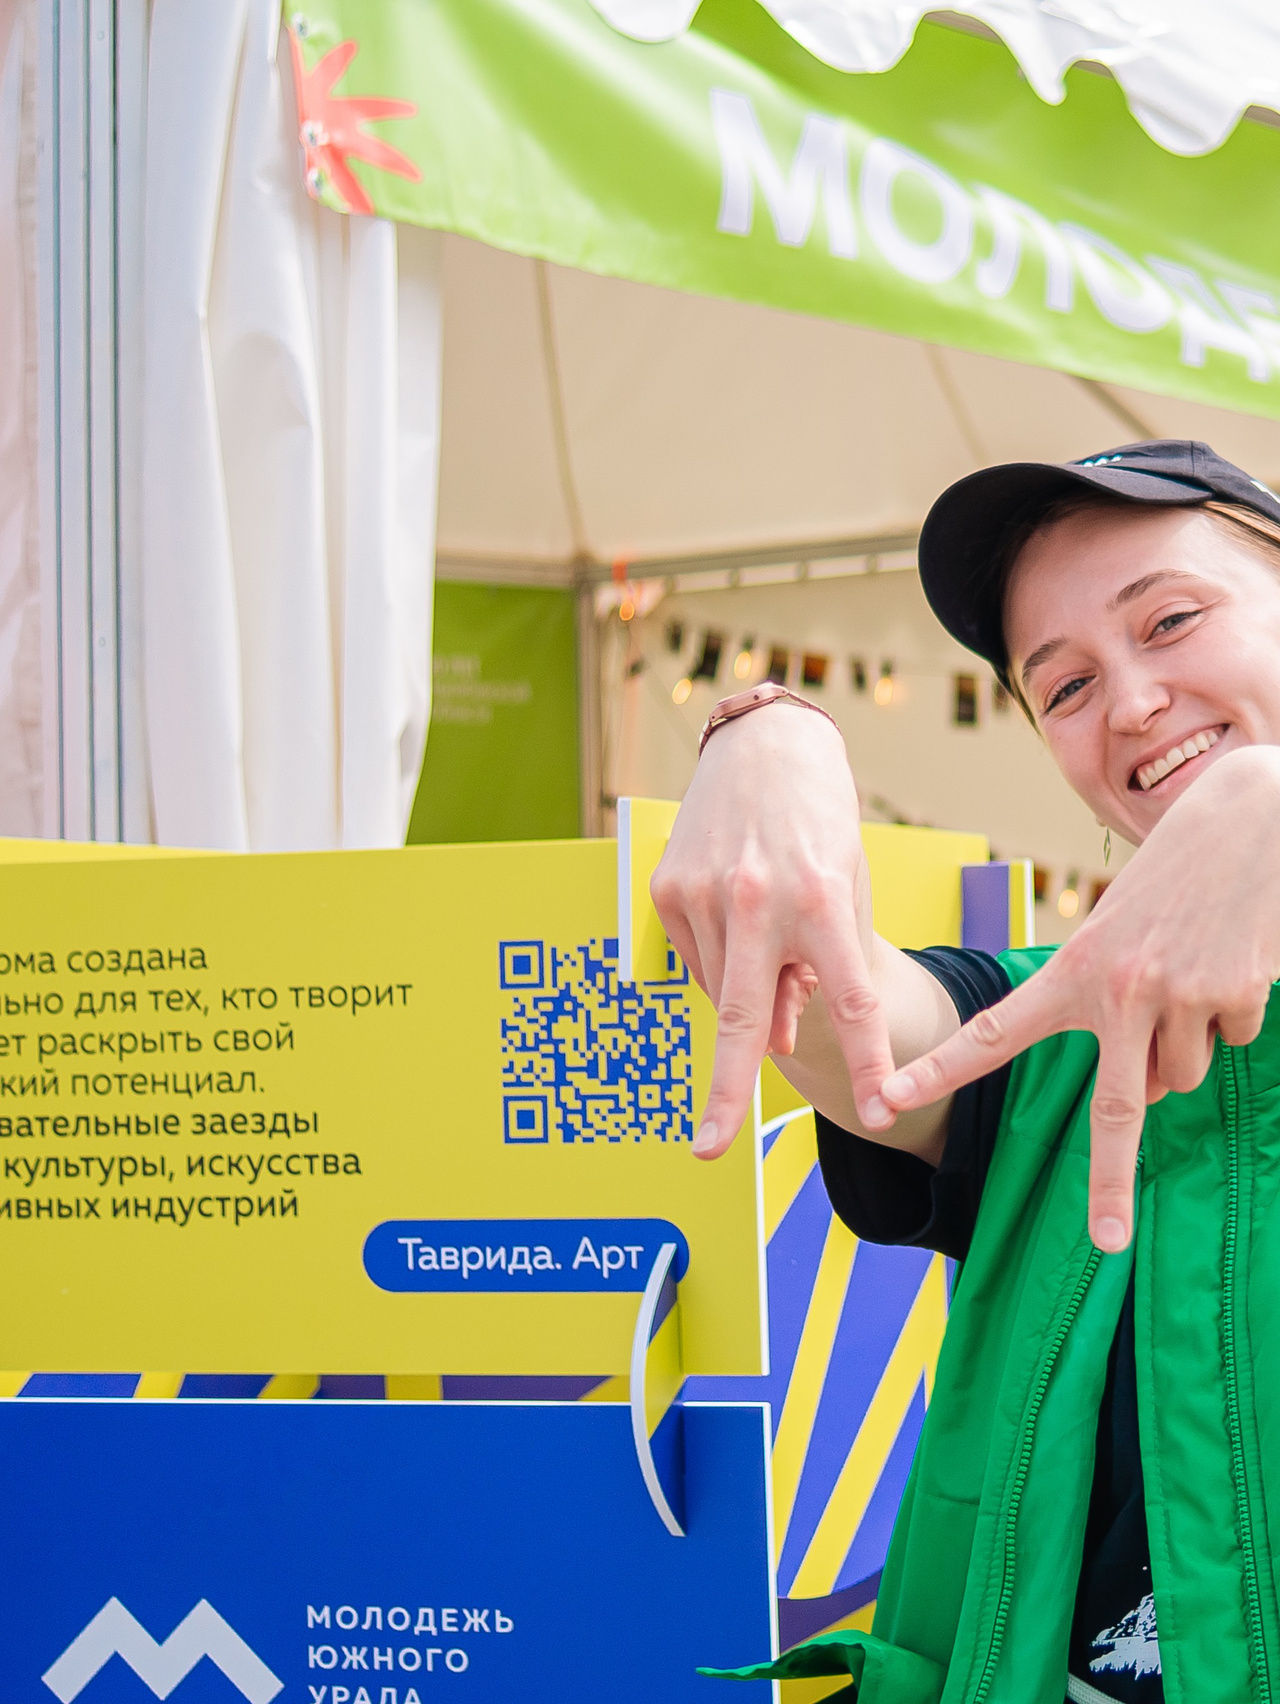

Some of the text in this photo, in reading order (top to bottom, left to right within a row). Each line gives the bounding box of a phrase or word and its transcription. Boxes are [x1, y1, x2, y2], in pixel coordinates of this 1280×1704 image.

[66, 946, 209, 977] создана
[0, 983, 413, 1019] ьно для тех, кто творит
[38, 1030, 203, 1064] раскрыть
[213, 1021, 295, 1052] свой
[1, 1067, 265, 1099] кий потенциал.
[190, 1111, 319, 1139] заезды
[4, 1151, 363, 1188] культуры, искусства
[112, 1188, 298, 1227] индустрий
[397, 1235, 644, 1280] Таврида. Арт
[306, 1604, 515, 1637] МОЛОДЕЖЬ
[307, 1645, 470, 1673] ЮЖНОГО
[307, 1684, 423, 1704] УРАЛА
